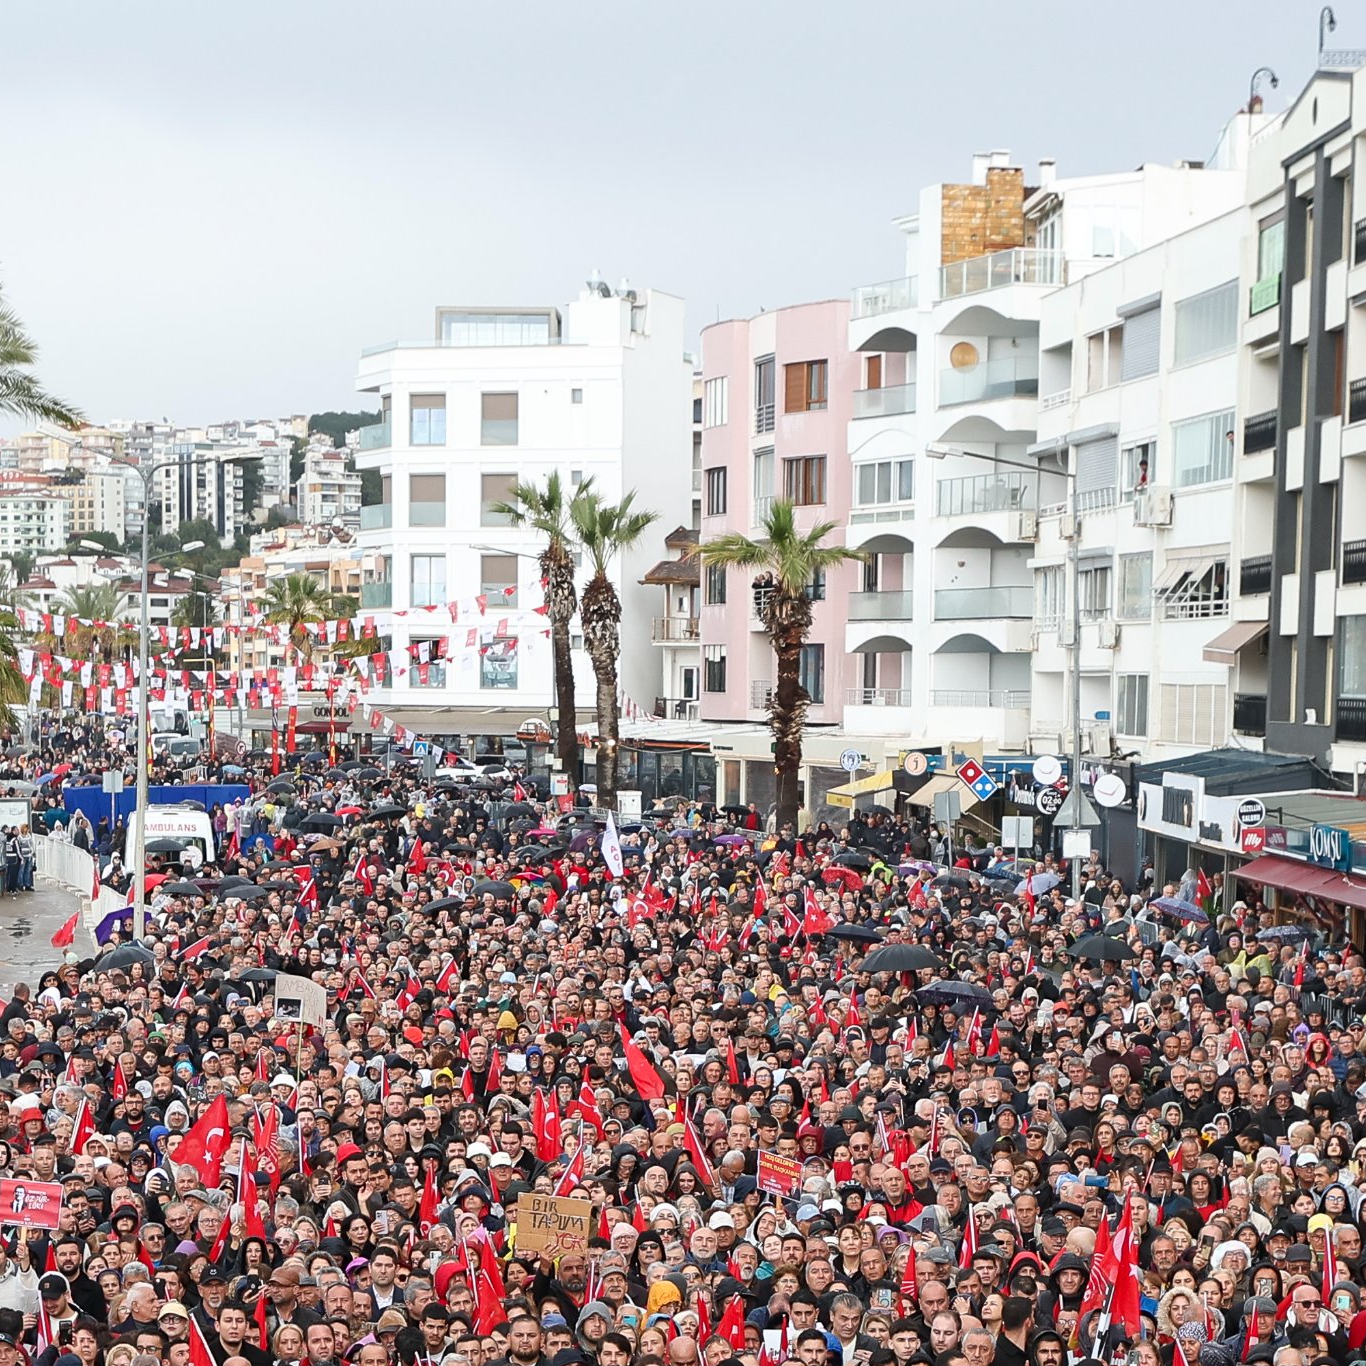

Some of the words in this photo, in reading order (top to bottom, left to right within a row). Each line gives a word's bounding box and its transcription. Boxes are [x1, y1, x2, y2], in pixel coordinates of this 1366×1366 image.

[1245, 833, 1262, 847] illy
[1309, 826, 1342, 868] KOMŞU
[529, 1212, 583, 1232] TAPUM
[555, 1232, 585, 1252] YOK
